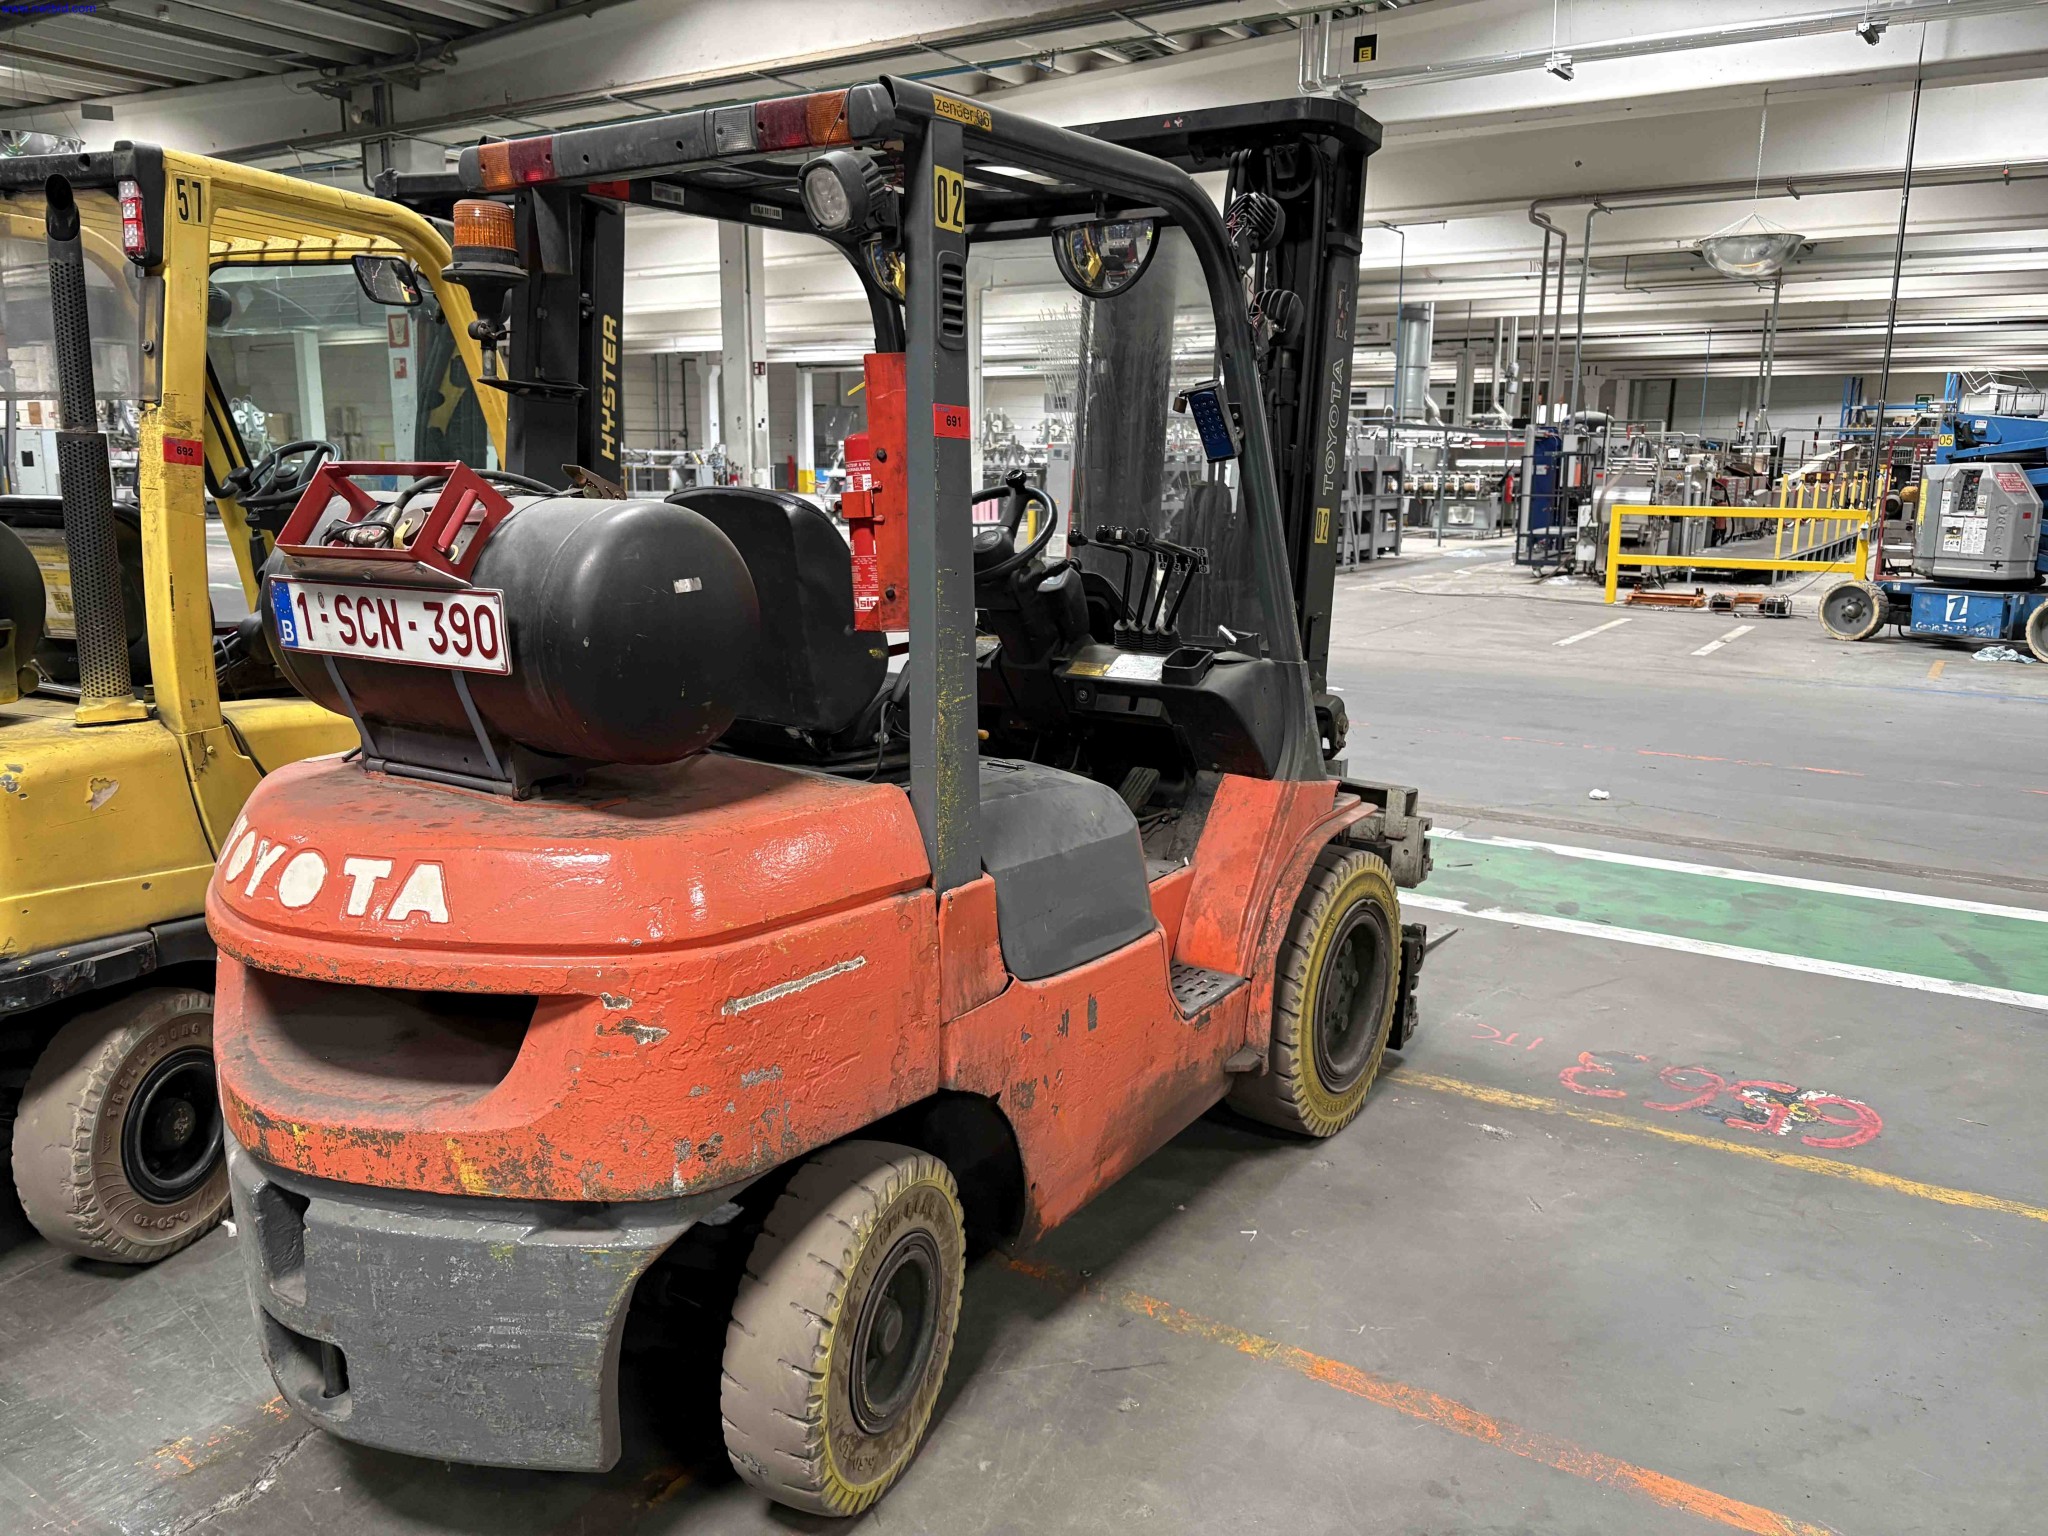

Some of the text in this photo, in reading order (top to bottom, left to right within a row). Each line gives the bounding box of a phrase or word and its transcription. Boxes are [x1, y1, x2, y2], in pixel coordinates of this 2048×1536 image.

[1361, 49, 1370, 59] E
[176, 178, 202, 223] 57
[937, 174, 963, 228] 02
[601, 314, 617, 461] HYSTER
[946, 415, 962, 428] 691
[1322, 357, 1345, 497] TOYOTA
[176, 446, 194, 457] 692
[1939, 435, 1954, 446] 05
[1316, 511, 1329, 540] 02
[282, 619, 295, 642] B
[297, 592, 499, 660] 1-SCN-390
